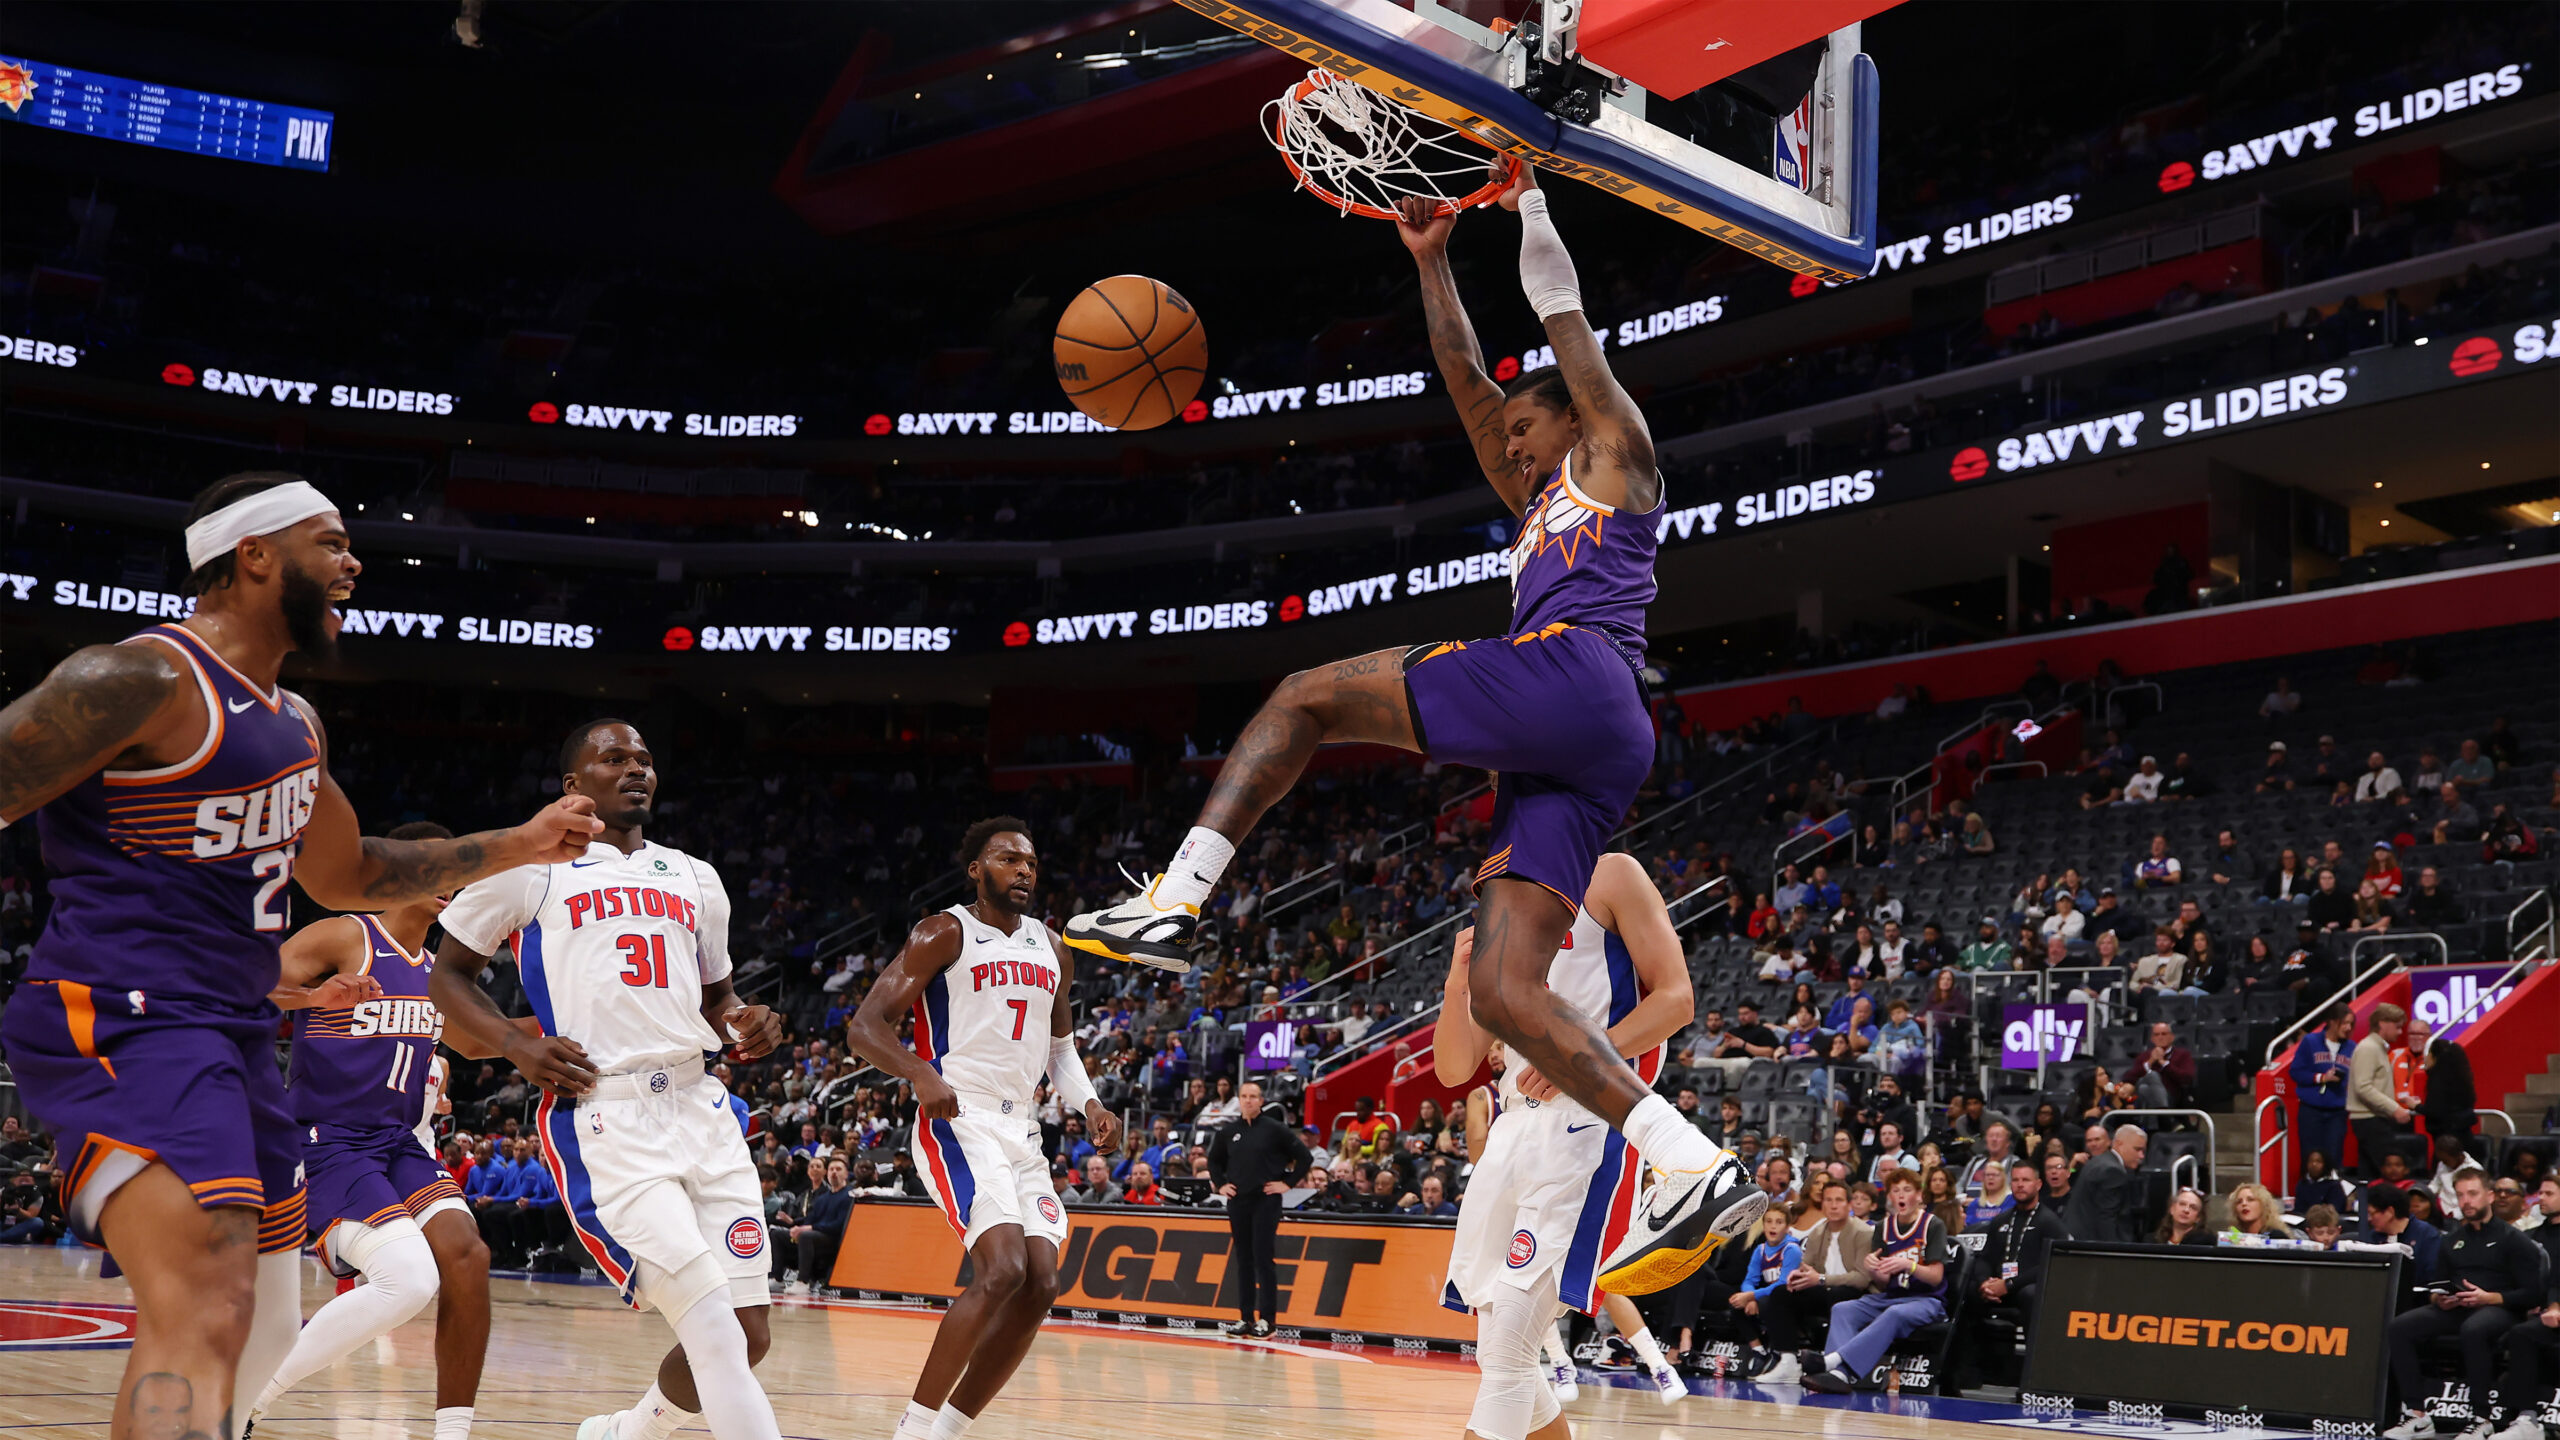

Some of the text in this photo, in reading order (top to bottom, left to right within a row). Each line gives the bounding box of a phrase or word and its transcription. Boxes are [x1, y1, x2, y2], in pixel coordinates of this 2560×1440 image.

[56, 69, 72, 78] TEAM
[143, 84, 165, 95] PLAYER
[285, 117, 328, 162] PHX
[2202, 64, 2523, 180] SAVVY SLIDERS
[1448, 115, 1638, 194] RUGIET
[1780, 157, 1796, 182] NBA
[1943, 195, 2074, 255] SLIDERS
[1618, 296, 1723, 347] SLIDERS
[202, 369, 453, 415] SAVVY SLIDERS
[1212, 371, 1426, 420] SAVVY SLIDERS
[565, 404, 797, 437] SAVVY SLIDERS
[897, 412, 998, 435] SAVVY
[1997, 367, 2348, 472] SAVVY SLIDERS
[1735, 469, 1875, 527] SLIDERS
[1307, 548, 1510, 616] SAVVY SLIDERS
[331, 607, 594, 649] AVVY SLIDERS
[700, 626, 951, 651] SAVVY SLIDERS
[1036, 600, 1268, 644] SAVVY SLIDERS
[1333, 658, 1378, 682] 2002
[192, 765, 320, 859] SUNS
[564, 886, 696, 934] PISTONS
[615, 933, 669, 989] 31
[970, 960, 1056, 996] PISTONS
[350, 999, 436, 1037] SUNS
[1006, 999, 1028, 1041] 7
[2003, 1008, 2084, 1062] ally
[1258, 1022, 1296, 1058] all
[386, 1040, 415, 1094] 11
[1071, 1309, 1099, 1320] StockX
[1119, 1313, 1147, 1324] StockX
[1167, 1317, 1196, 1329] StockX
[1276, 1329, 1301, 1339] tockX
[1331, 1332, 1364, 1344] StockX
[1393, 1338, 1428, 1350] StockX
[1460, 1343, 1477, 1355] Sto
[1702, 1340, 1740, 1358] Little
[2066, 1310, 2349, 1357] RUGIET.COM
[1872, 1365, 1932, 1388] Csars
[2022, 1392, 2075, 1409] StockX
[2107, 1400, 2164, 1418] StockX
[2205, 1410, 2264, 1427] StockX
[2312, 1418, 2377, 1437] StockX
